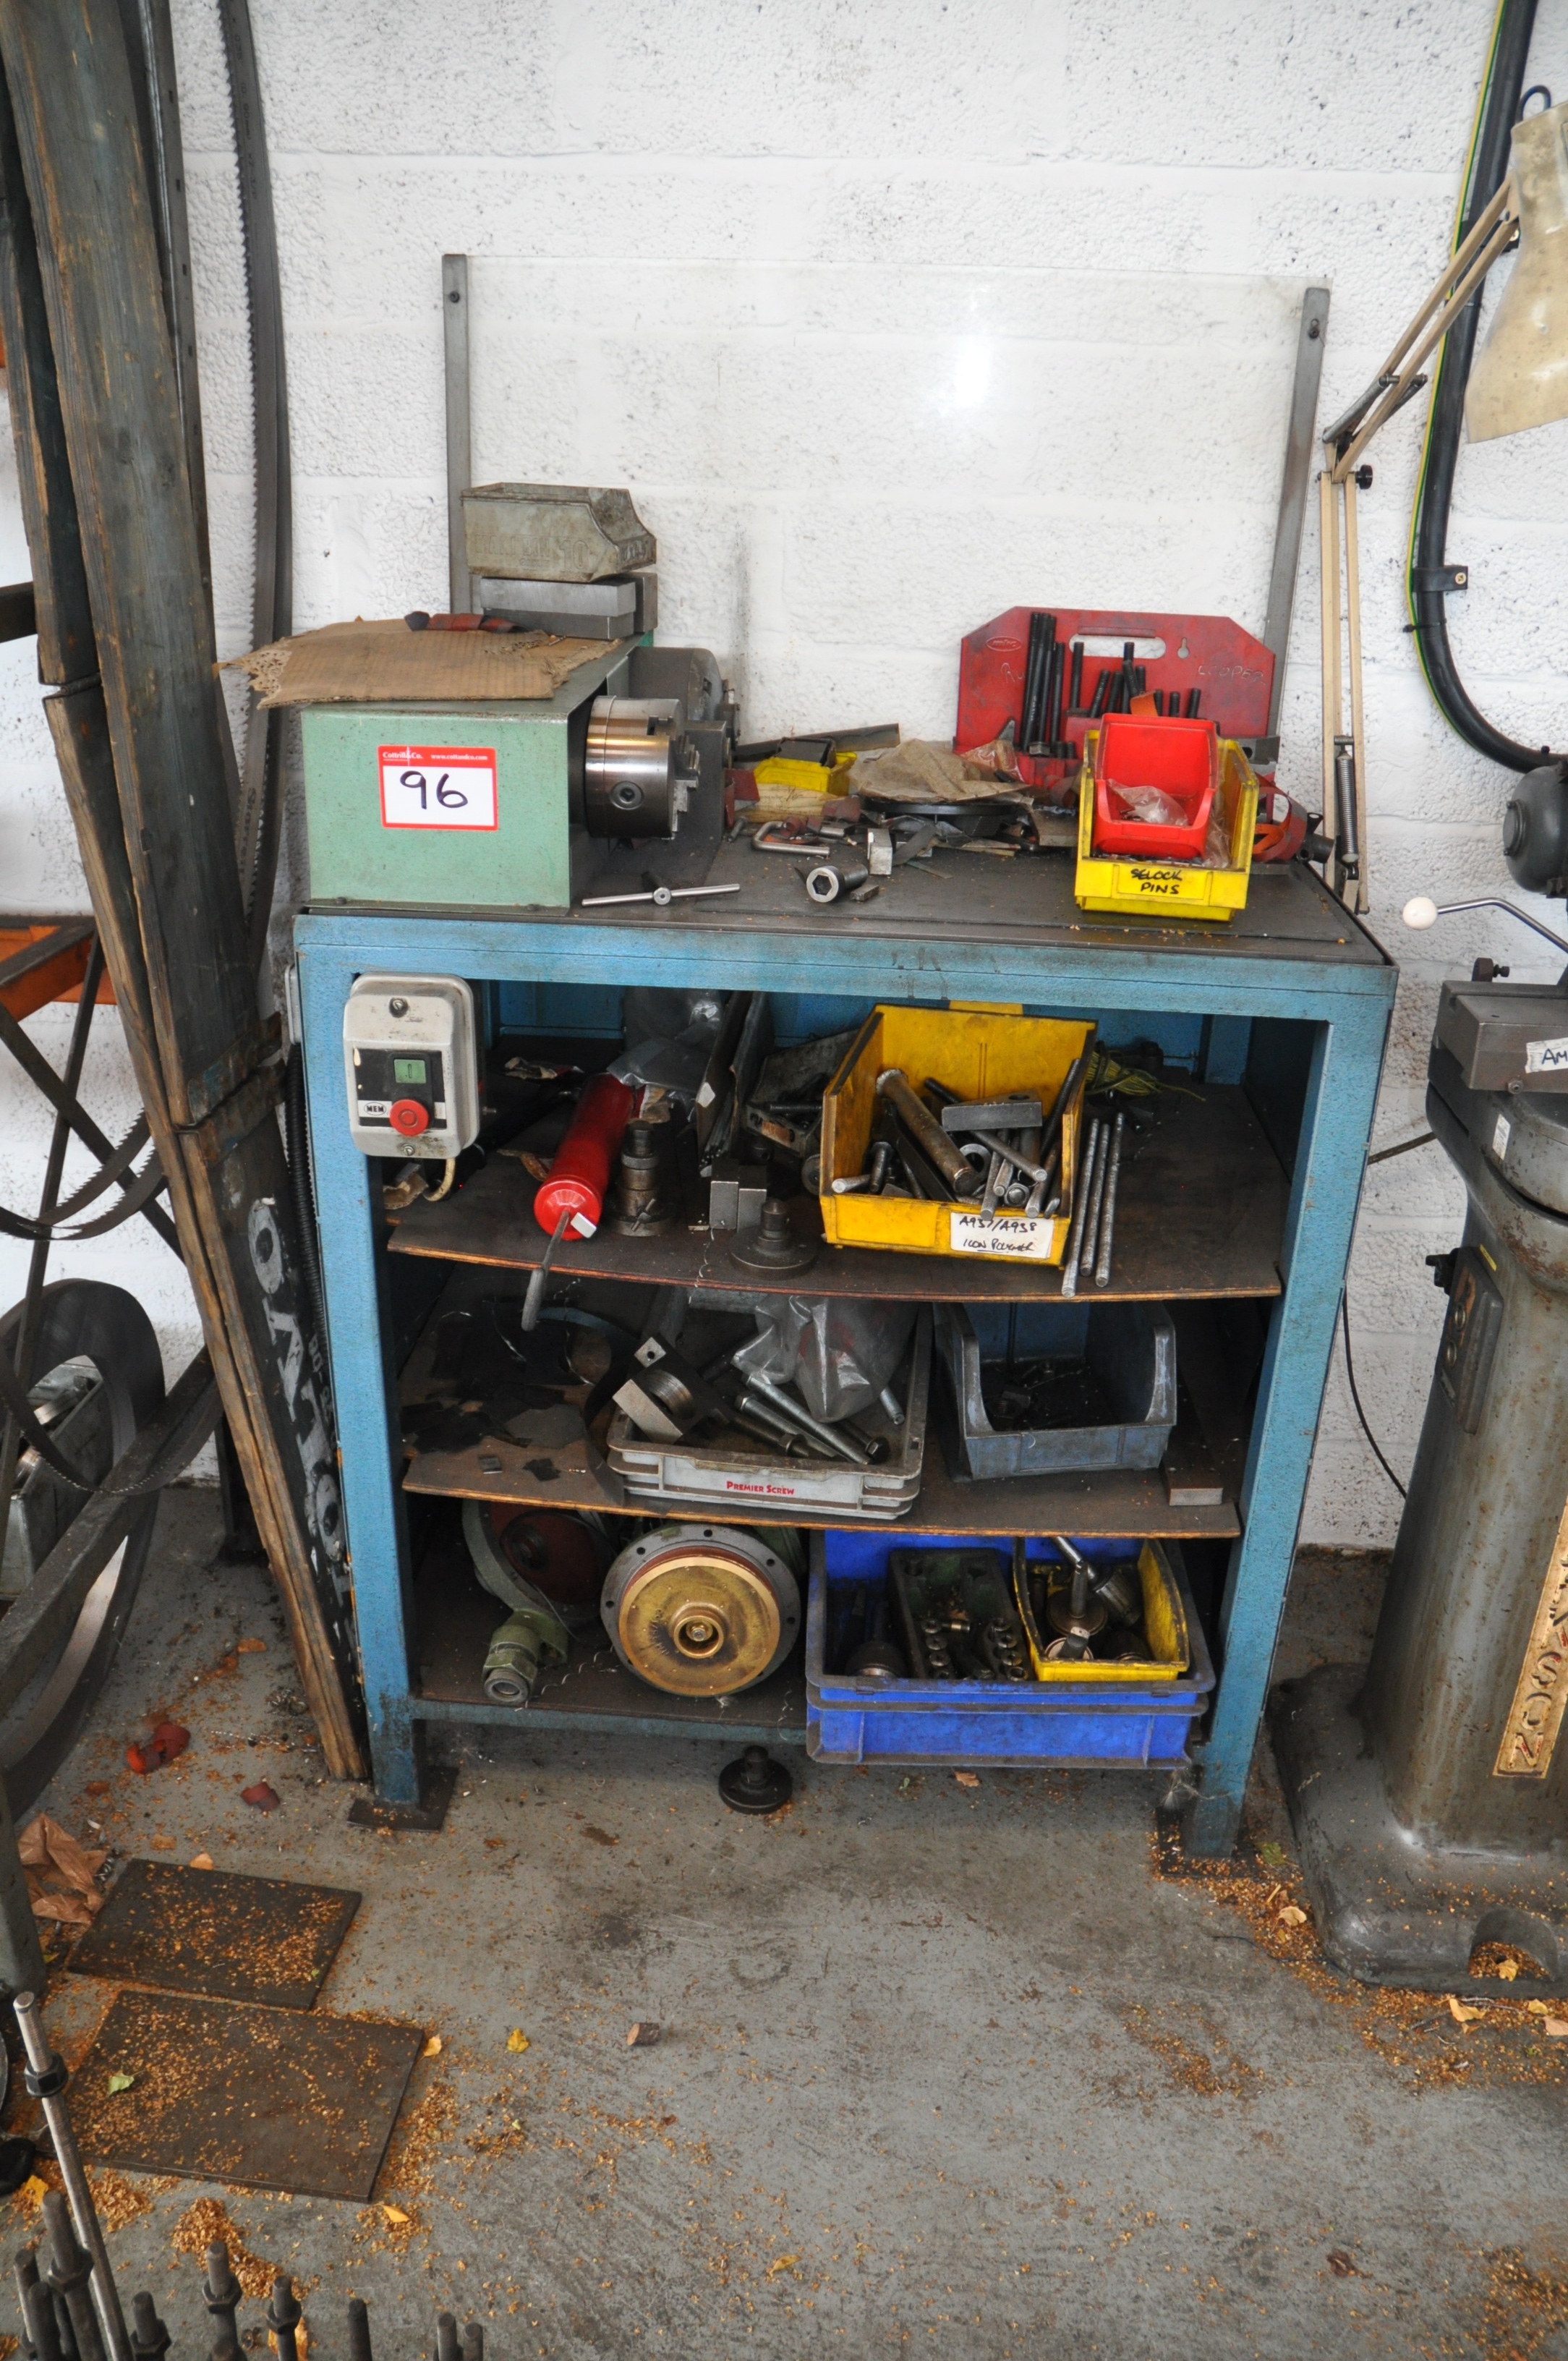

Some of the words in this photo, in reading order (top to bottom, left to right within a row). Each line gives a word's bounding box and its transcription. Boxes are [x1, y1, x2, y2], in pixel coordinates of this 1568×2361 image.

[399, 770, 469, 809] 96
[1130, 868, 1183, 882] SELOCK
[1141, 882, 1180, 895] PINS
